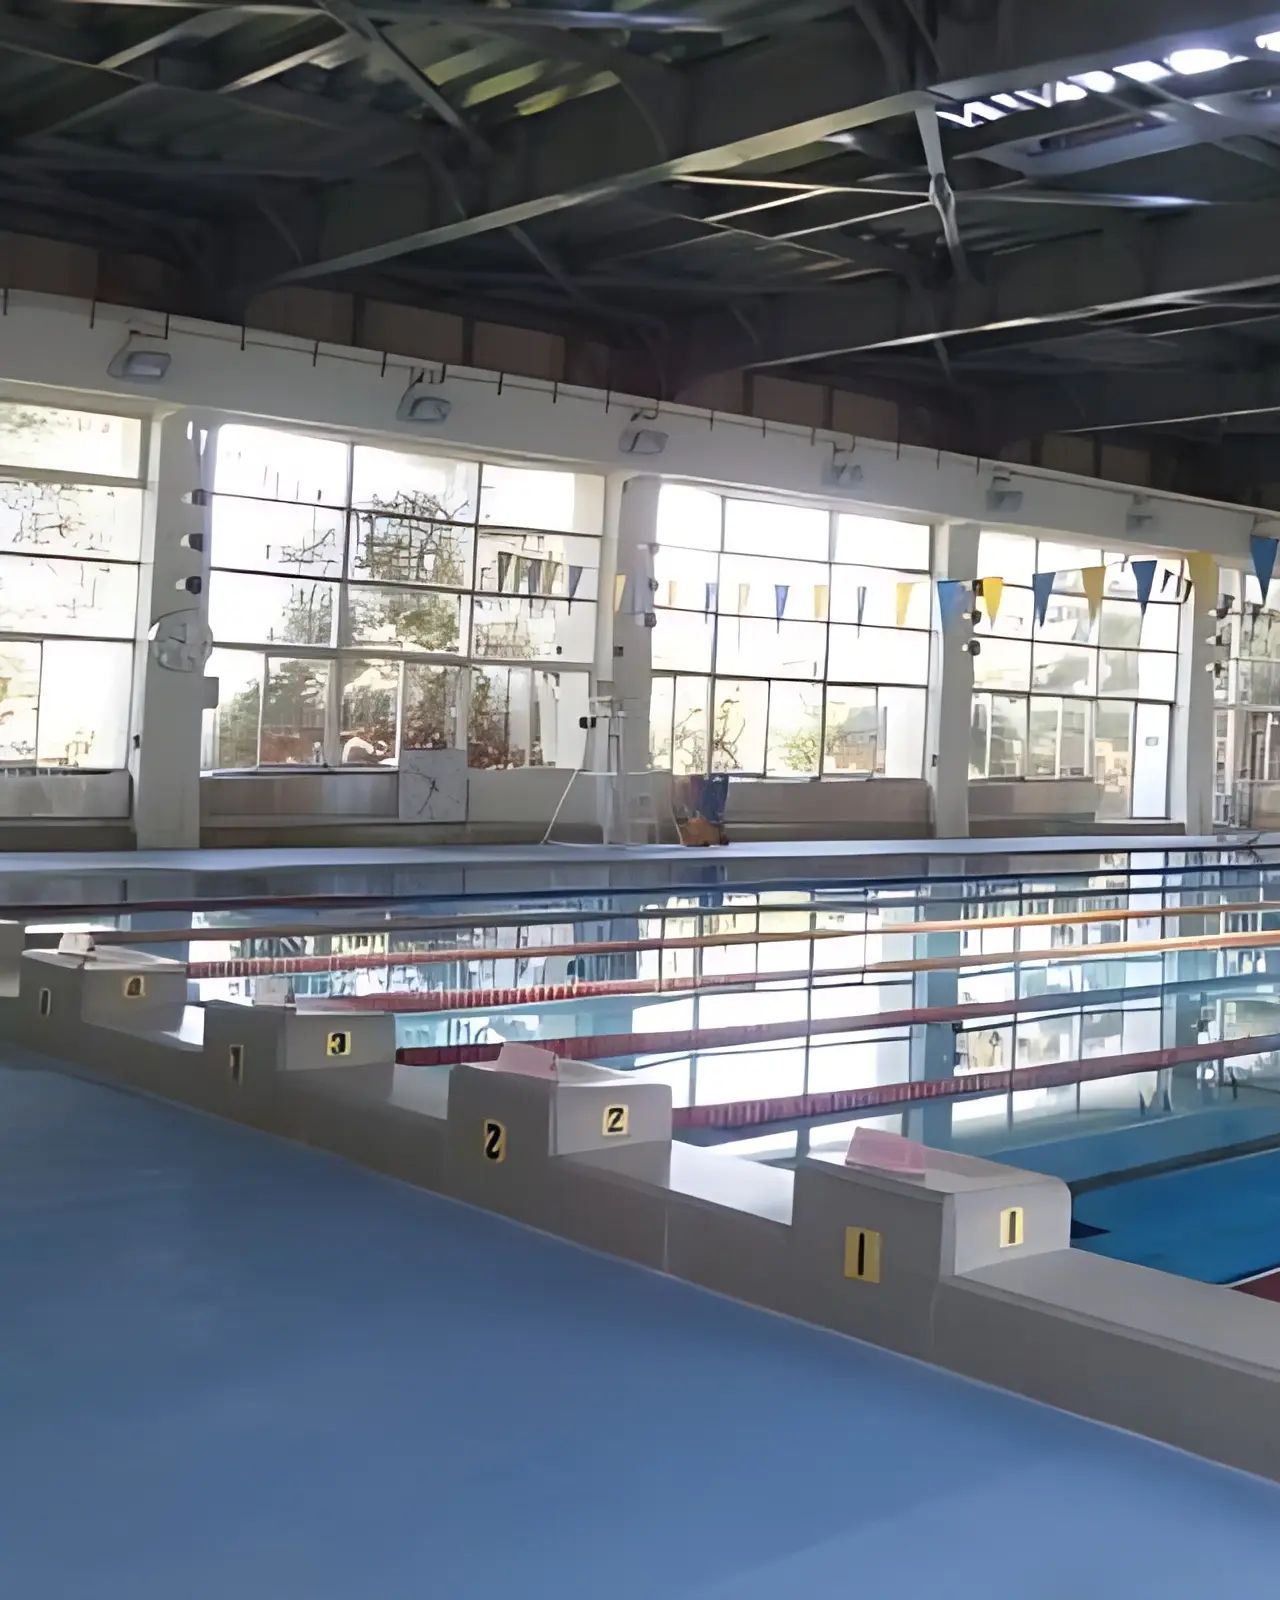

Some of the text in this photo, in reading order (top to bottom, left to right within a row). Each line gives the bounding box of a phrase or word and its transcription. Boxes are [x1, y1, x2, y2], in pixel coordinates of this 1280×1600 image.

[331, 1032, 347, 1055] 3
[607, 1107, 624, 1133] 2
[485, 1123, 501, 1160] 2
